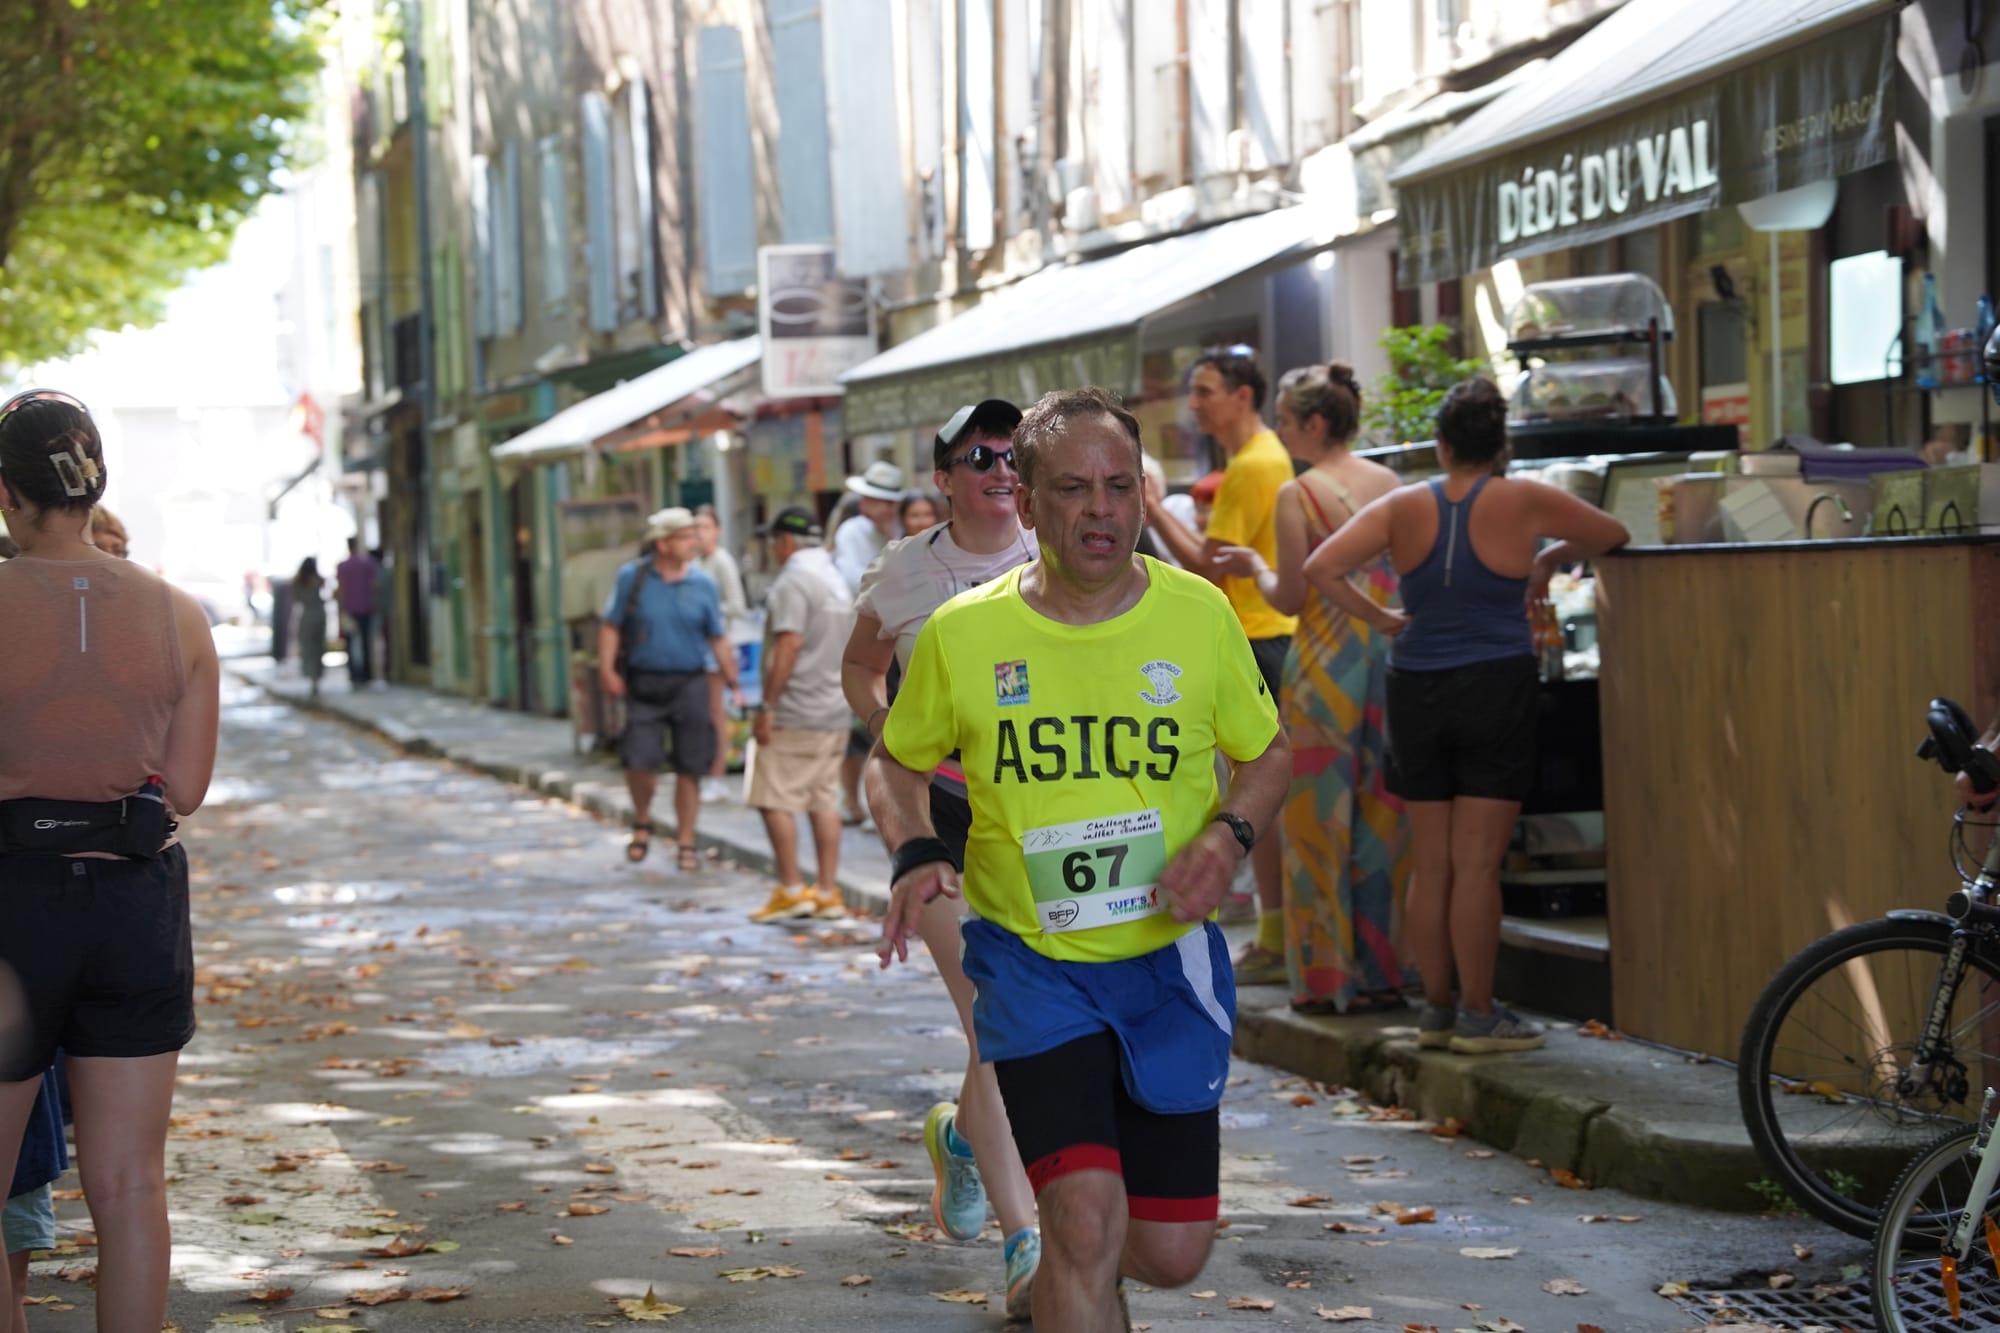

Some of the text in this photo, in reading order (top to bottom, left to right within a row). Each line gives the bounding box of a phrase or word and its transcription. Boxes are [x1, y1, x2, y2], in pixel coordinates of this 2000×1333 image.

[1498, 120, 1718, 244] DÉDÉ DU VAL
[993, 715, 1180, 784] ASICS
[1086, 818, 1132, 832] Challenge
[1062, 844, 1129, 893] 67
[1048, 908, 1075, 921] BFP
